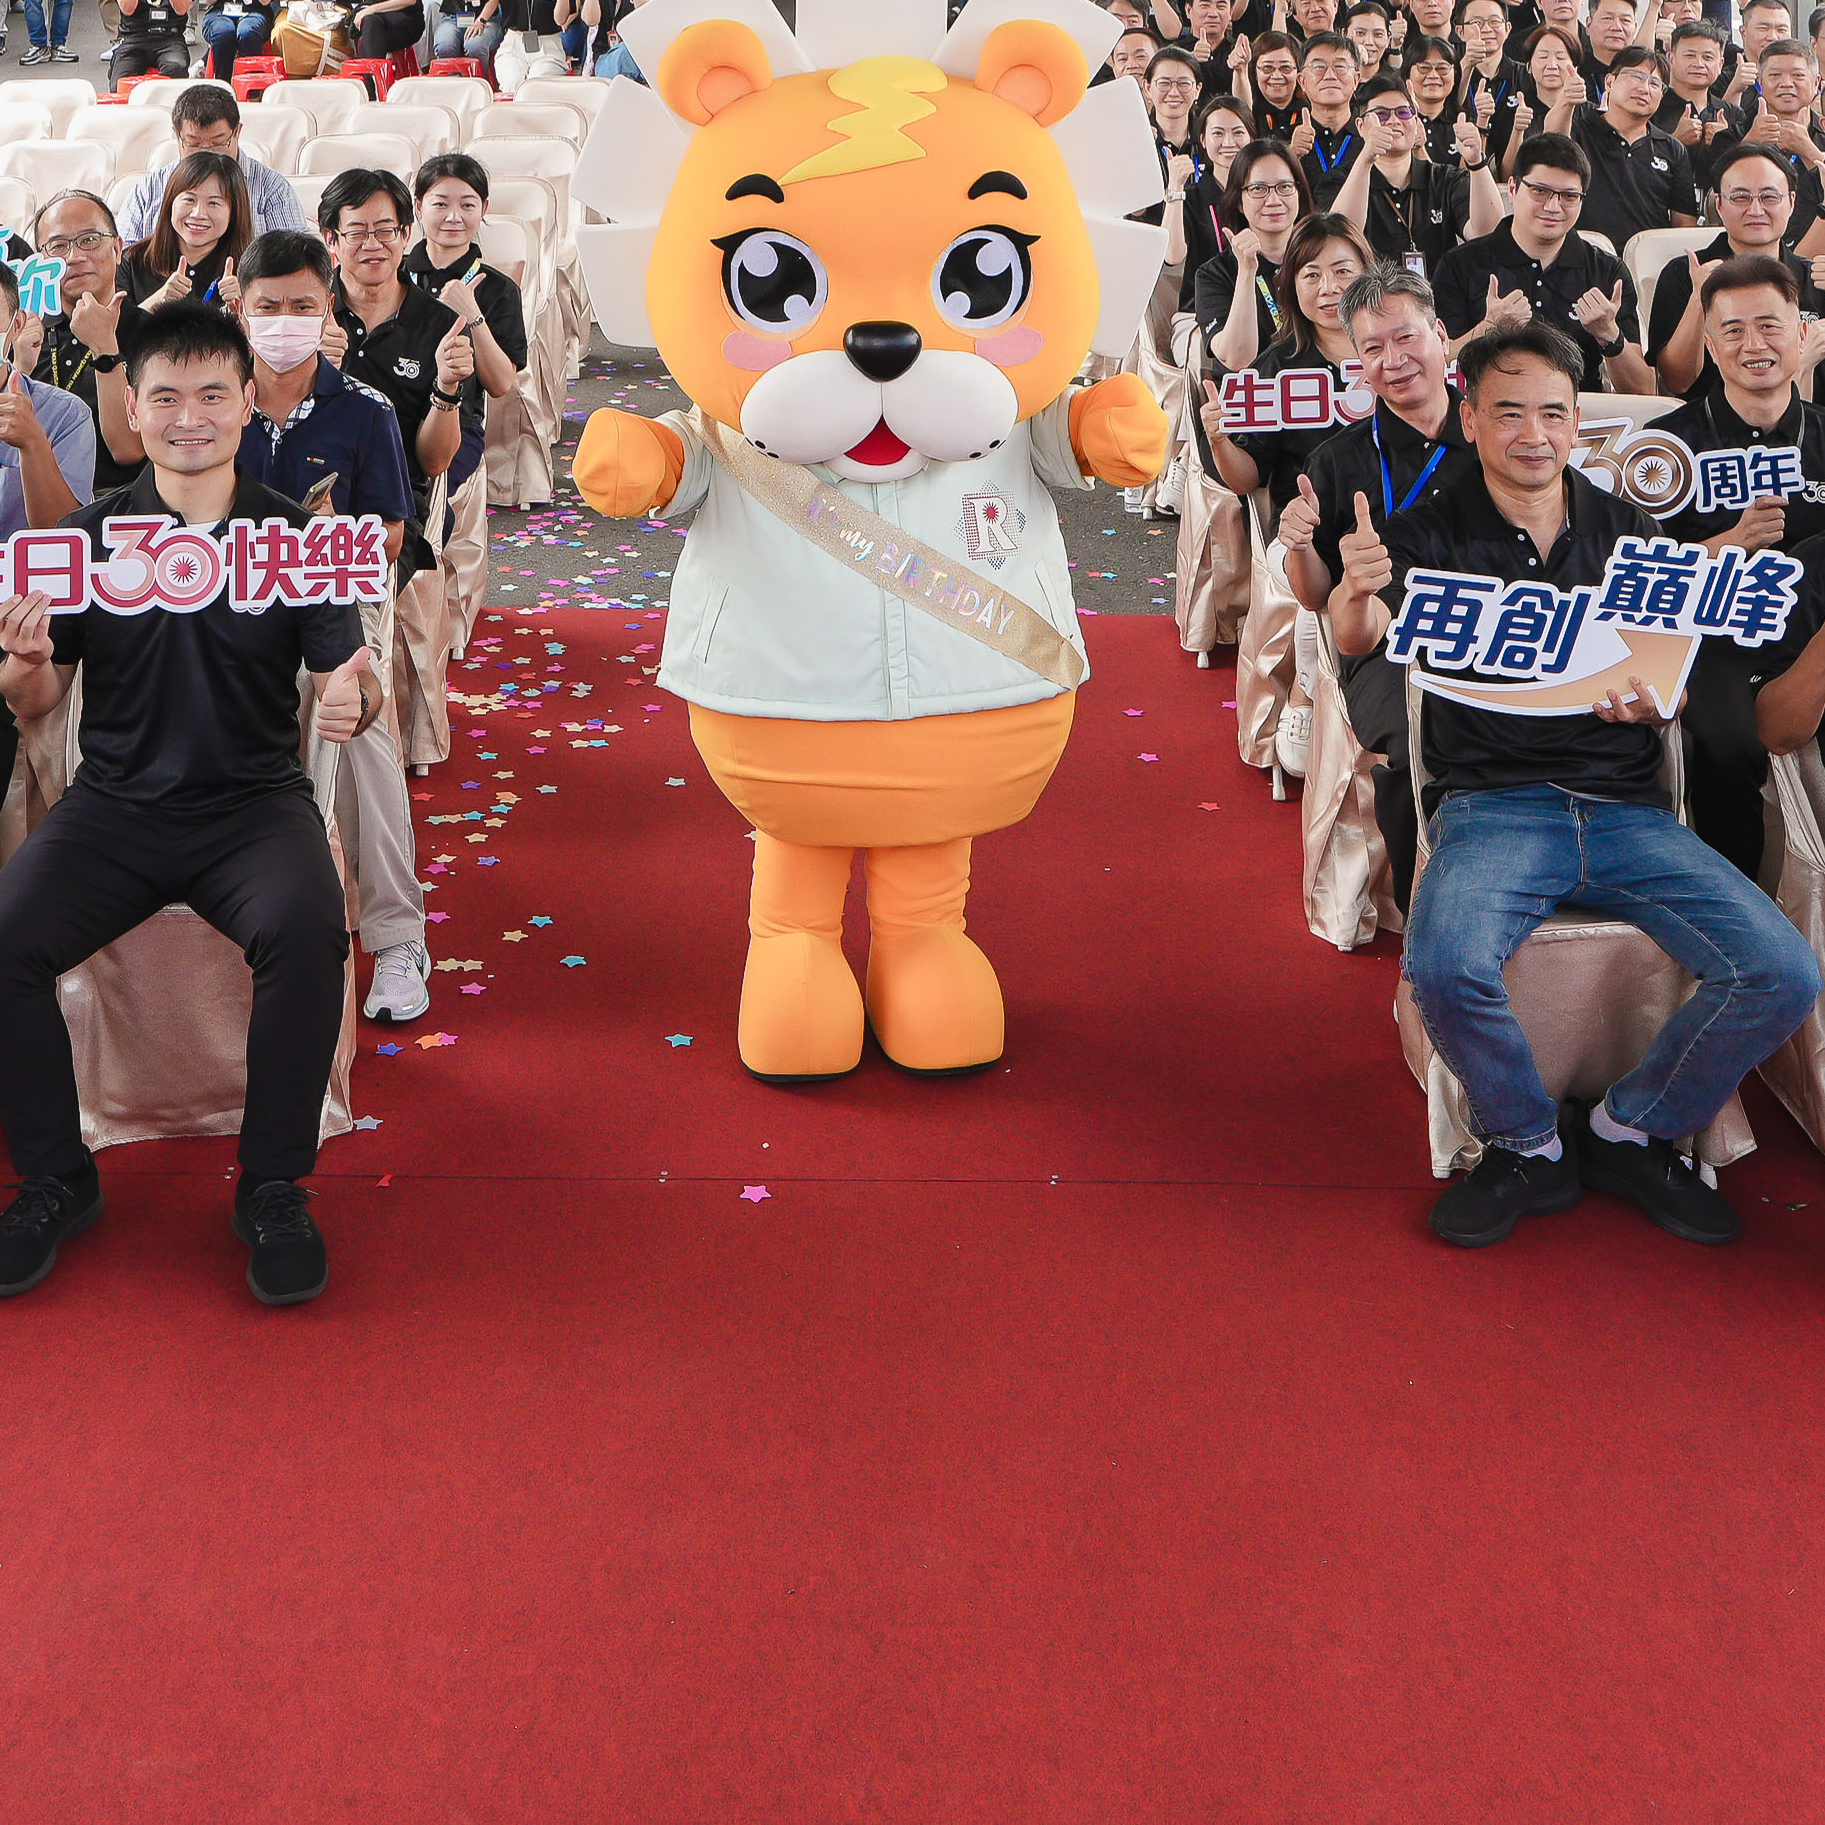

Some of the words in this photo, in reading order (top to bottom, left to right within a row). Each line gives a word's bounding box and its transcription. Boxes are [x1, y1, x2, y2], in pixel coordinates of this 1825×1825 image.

[392, 357, 422, 379] 30
[839, 527, 876, 562] my
[874, 542, 1016, 636] BIRTHDAY
[1394, 544, 1800, 674] 再創巔峰
